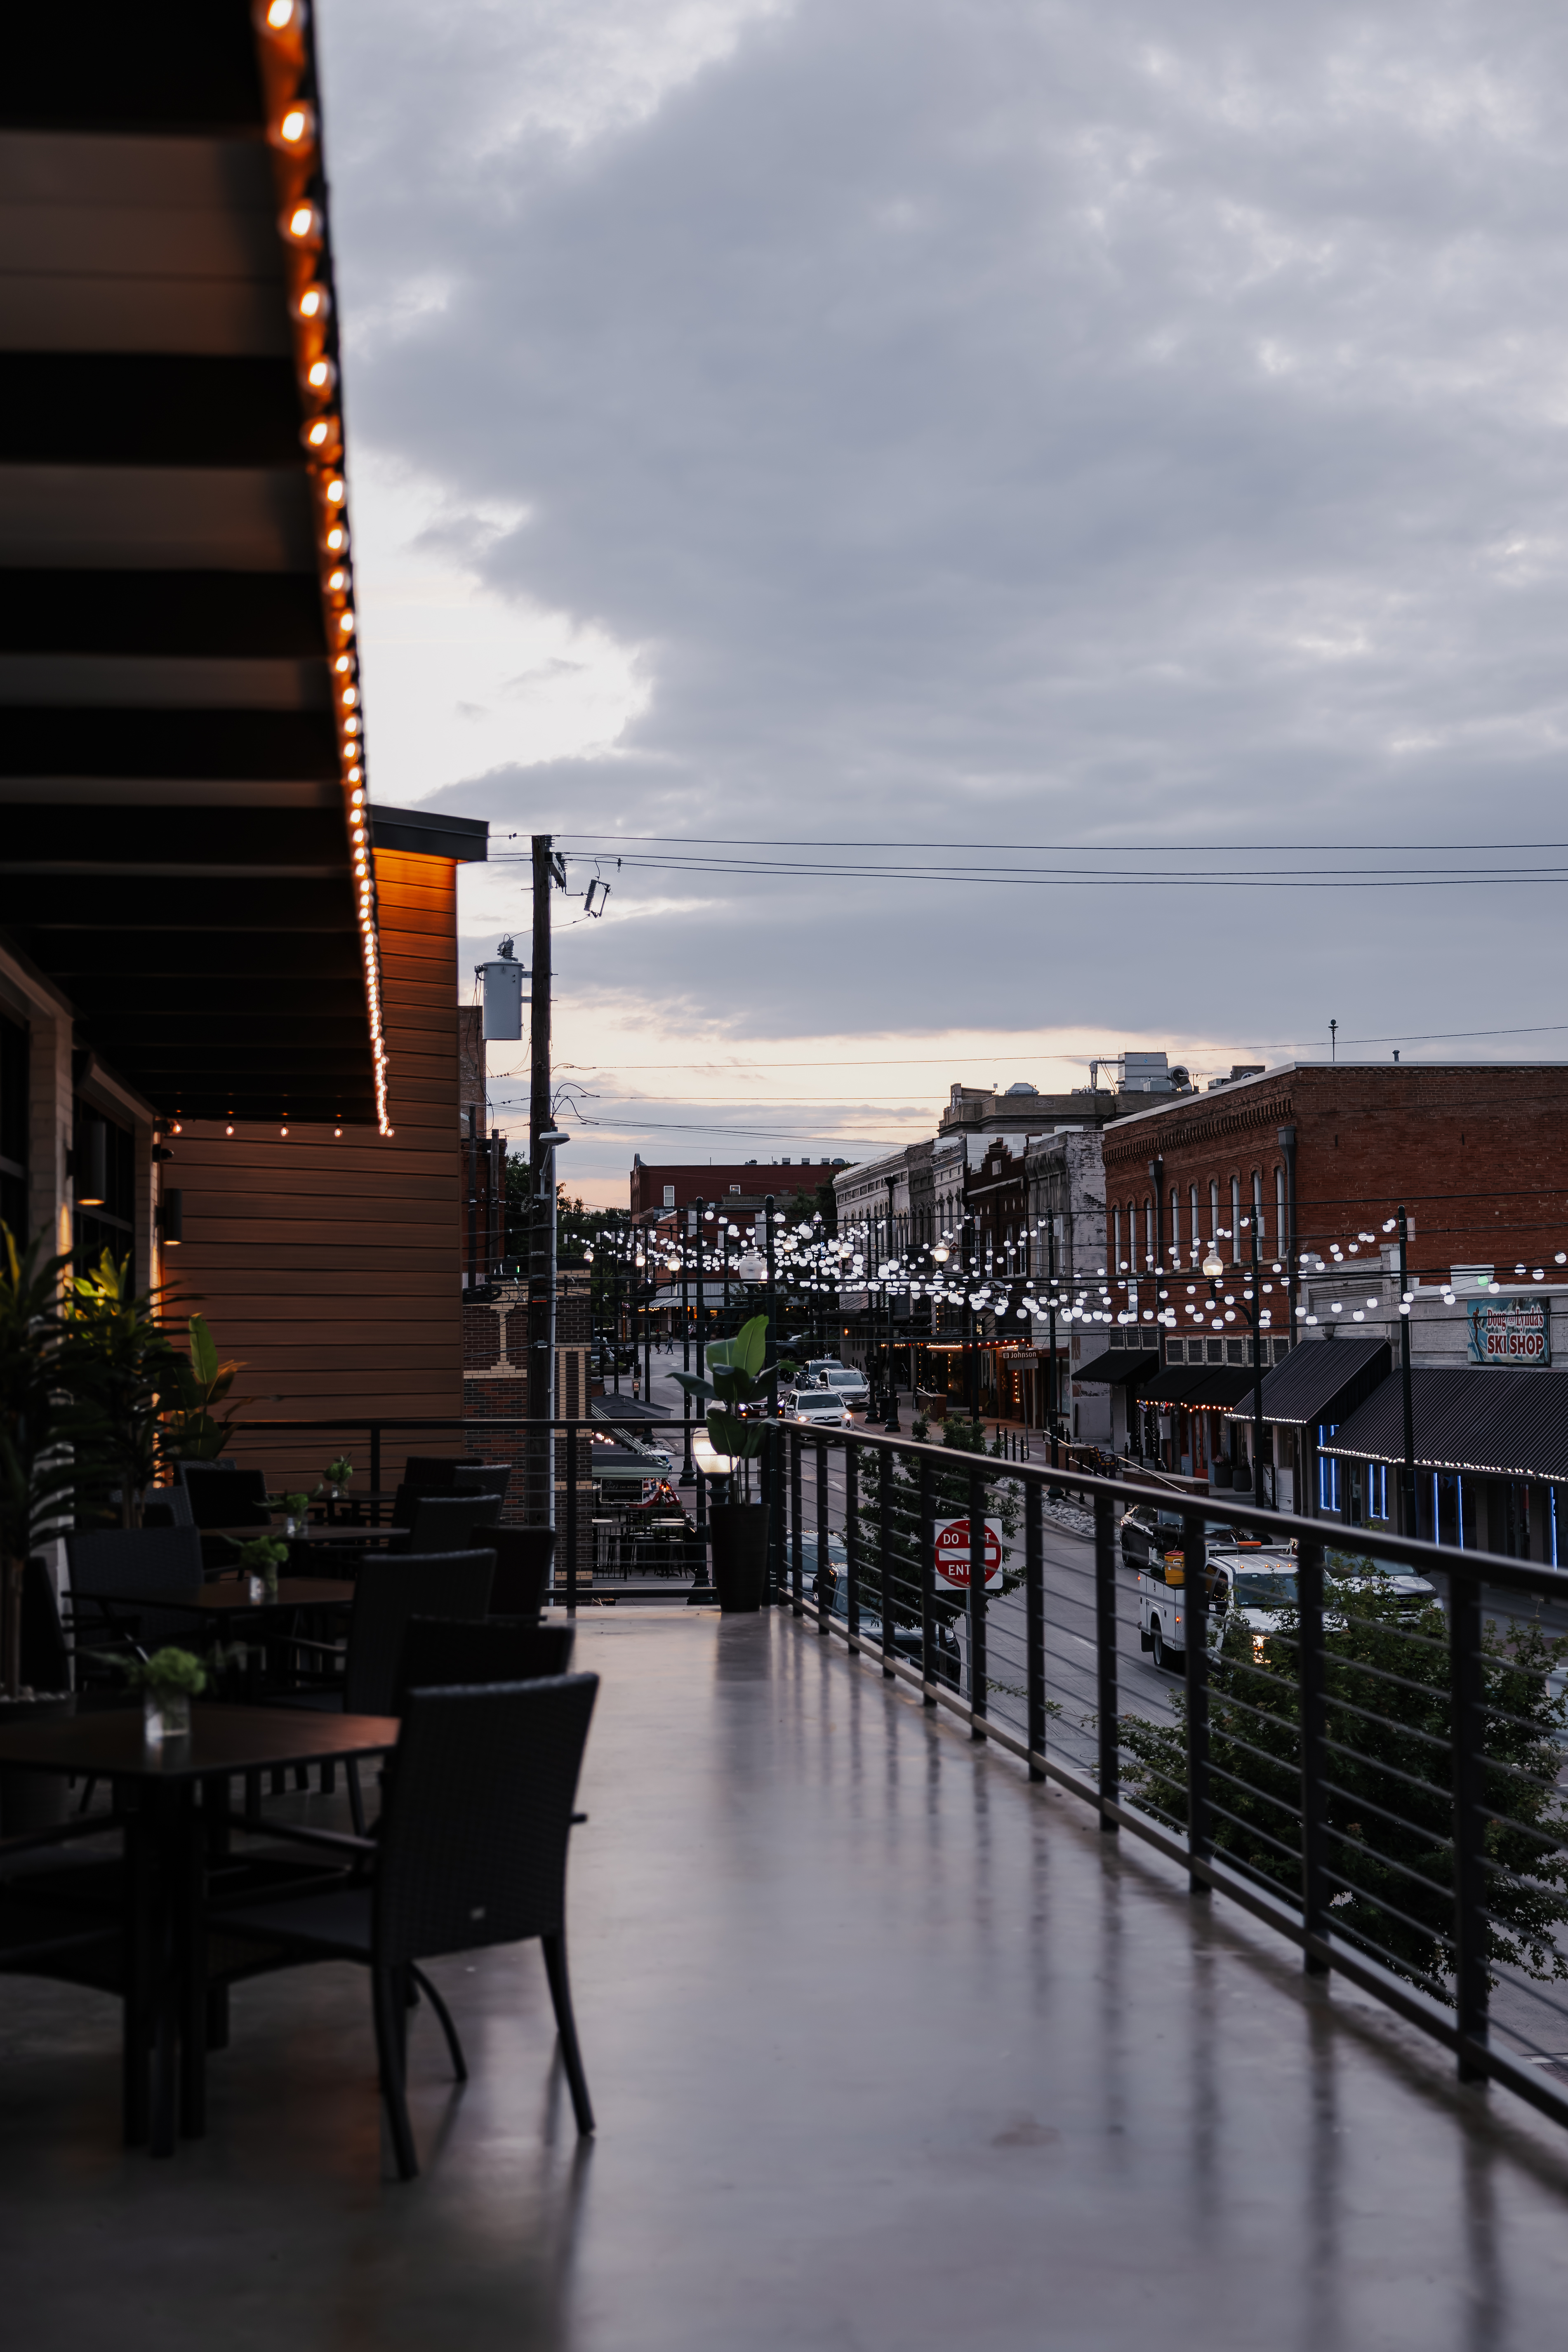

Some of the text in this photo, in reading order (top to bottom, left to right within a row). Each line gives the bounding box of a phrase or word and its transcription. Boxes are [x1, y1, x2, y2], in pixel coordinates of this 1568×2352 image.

[1488, 1309, 1506, 1331] Doug
[1516, 1307, 1543, 1332] Lynda's
[1488, 1335, 1543, 1355] SKI SHOP
[944, 1533, 959, 1544] DO
[949, 1565, 987, 1575] ENT
